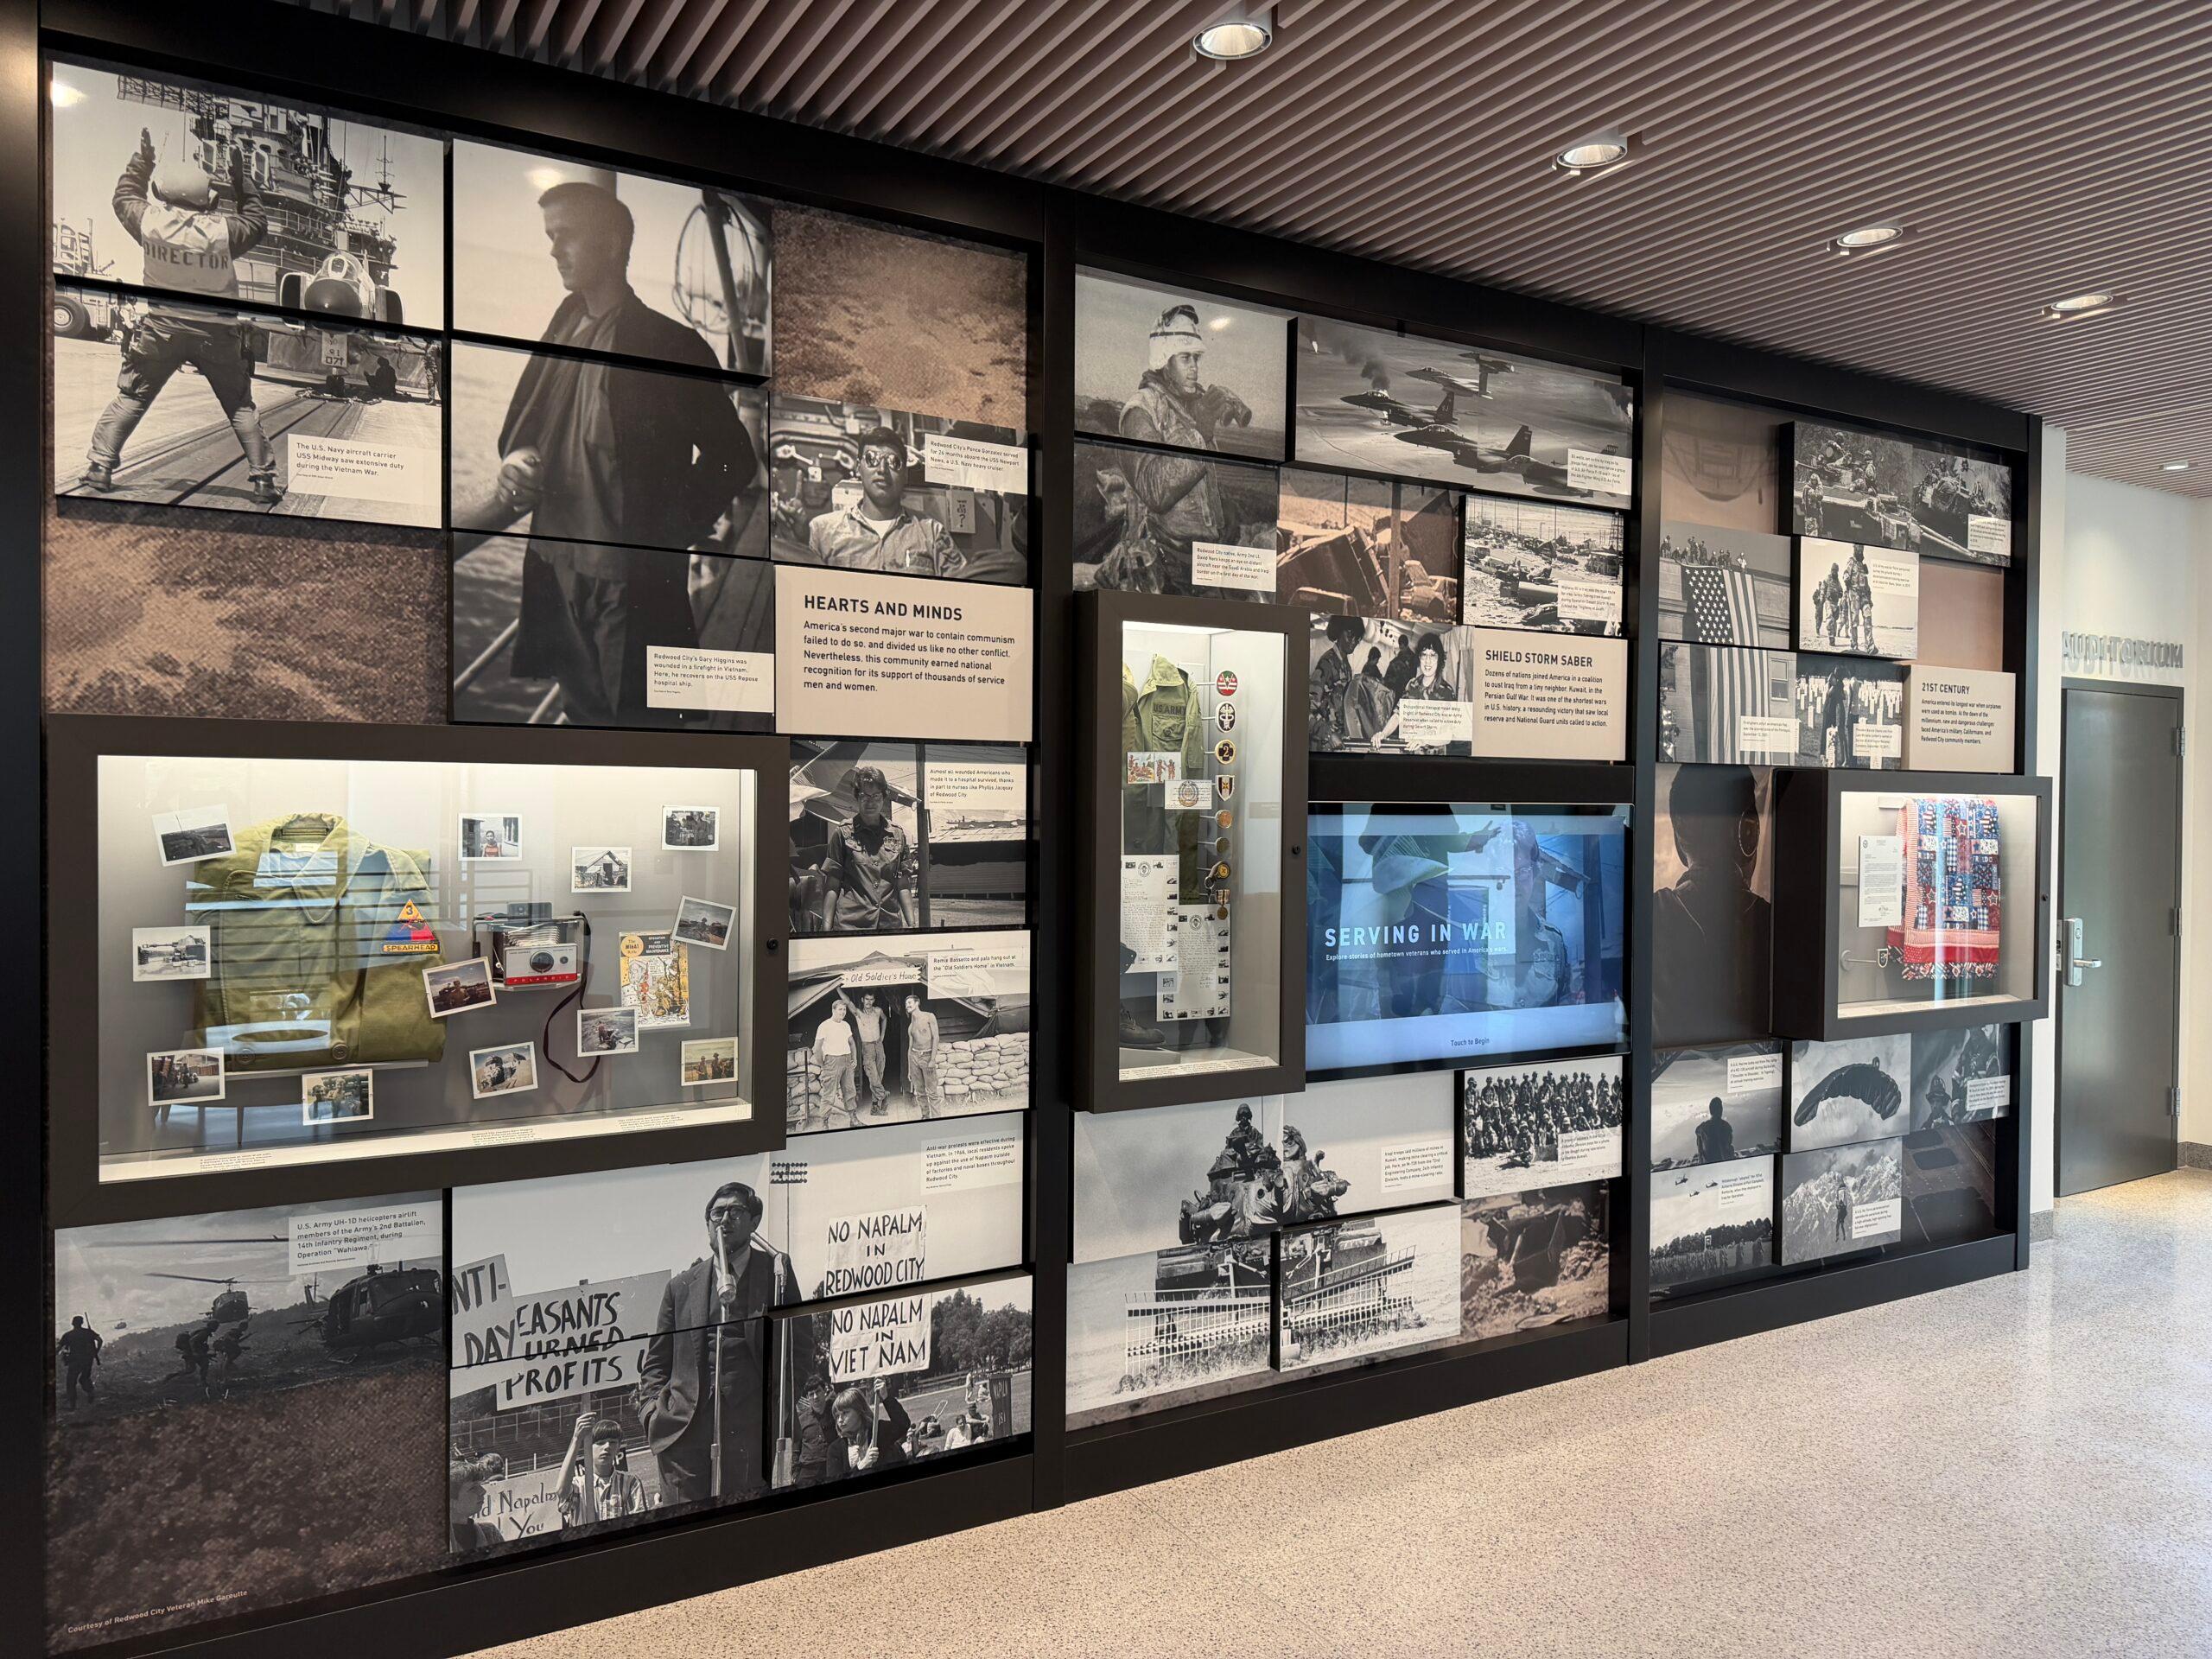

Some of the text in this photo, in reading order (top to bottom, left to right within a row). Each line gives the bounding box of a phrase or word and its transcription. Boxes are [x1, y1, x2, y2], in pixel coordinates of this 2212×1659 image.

[297, 463, 320, 471] during
[313, 454, 339, 463] Midway
[805, 596, 963, 620] HEARTS AND MINDS
[804, 621, 847, 631] America's
[882, 629, 906, 637] major
[967, 635, 1015, 643] communism
[804, 636, 828, 645] failed
[841, 638, 851, 647] do
[886, 642, 915, 651] divided
[930, 645, 944, 653] like
[2062, 631, 2183, 668] AUDITORIUM
[865, 655, 881, 663] this
[883, 658, 929, 667] community
[1486, 650, 1592, 667] SHIELD STORM SABER
[804, 667, 852, 676] recognition
[854, 668, 866, 676] for
[869, 669, 879, 677] its
[925, 673, 966, 682] thousands
[1922, 683, 1970, 694] 21ST CENTURY
[1153, 704, 1186, 716] US ARMY
[1223, 746, 1229, 757] 2
[406, 905, 413, 915] 3
[1325, 922, 1506, 947] SERVING IN WAR
[1326, 953, 1348, 961] Explore
[851, 973, 862, 982] Old
[297, 1232, 331, 1240] members
[829, 1211, 923, 1244] NO NAPALM
[344, 1235, 379, 1243] Regiment,
[867, 1243, 885, 1256] IN
[826, 1262, 893, 1295] REDWOOD
[452, 1262, 506, 1315] NTI-
[517, 1291, 620, 1336] EASANTS
[832, 1298, 923, 1336] NO NAPALM
[464, 1319, 515, 1369] DAY
[876, 1330, 893, 1342] IN
[830, 1338, 925, 1376] VIET NAM
[501, 1356, 622, 1401] PROFITS
[497, 1483, 558, 1515] Napalm
[510, 1512, 543, 1538] You
[68, 1622, 103, 1633] Courtesy
[114, 1611, 149, 1623] Redwood
[166, 1602, 195, 1611] Veteran
[215, 1591, 247, 1601] Garoutte
